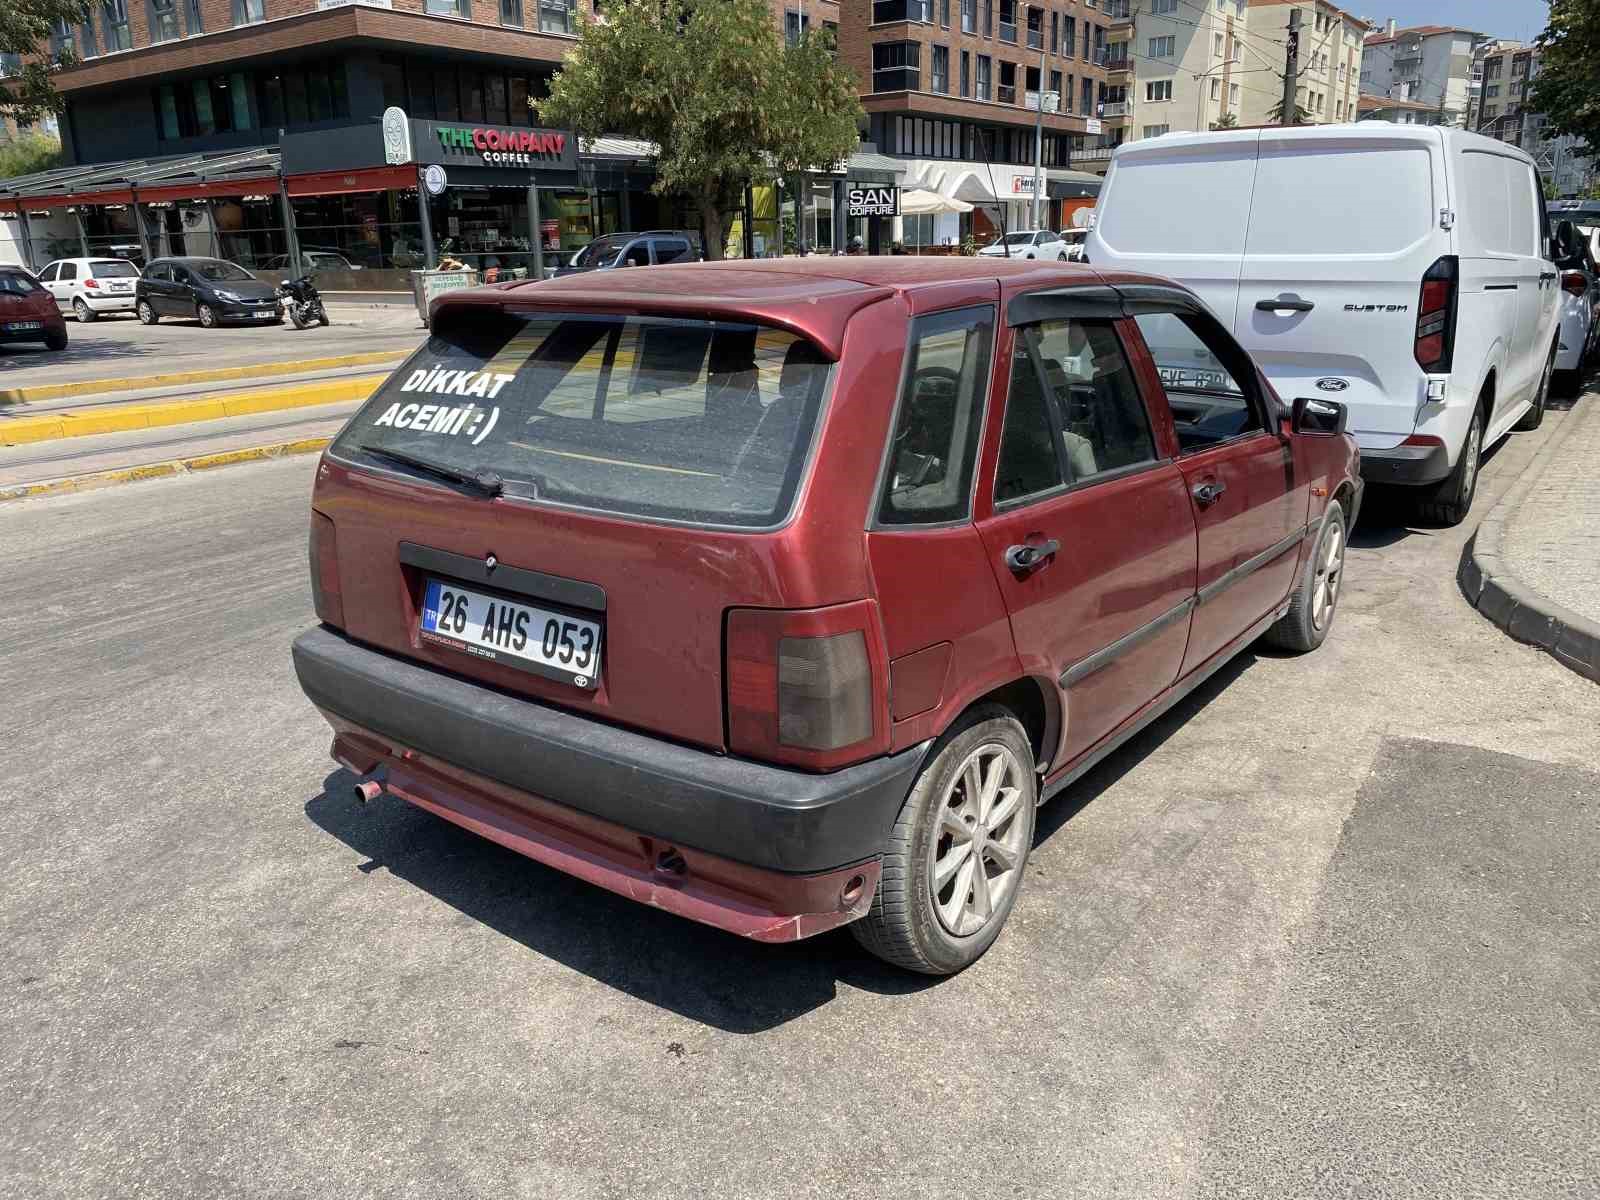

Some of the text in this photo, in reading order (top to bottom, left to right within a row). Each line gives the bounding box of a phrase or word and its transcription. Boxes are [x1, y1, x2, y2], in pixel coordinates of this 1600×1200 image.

[472, 128, 567, 153] COMPANY
[483, 152, 530, 163] COFFEE
[850, 189, 894, 206] SAN
[850, 206, 894, 216] COIFFURE
[1343, 304, 1408, 313] CUSTOM
[400, 364, 516, 399] DİKKAT
[426, 609, 436, 621] TR
[438, 591, 469, 634] 26
[480, 602, 531, 651] AHS
[542, 618, 594, 669] 053
